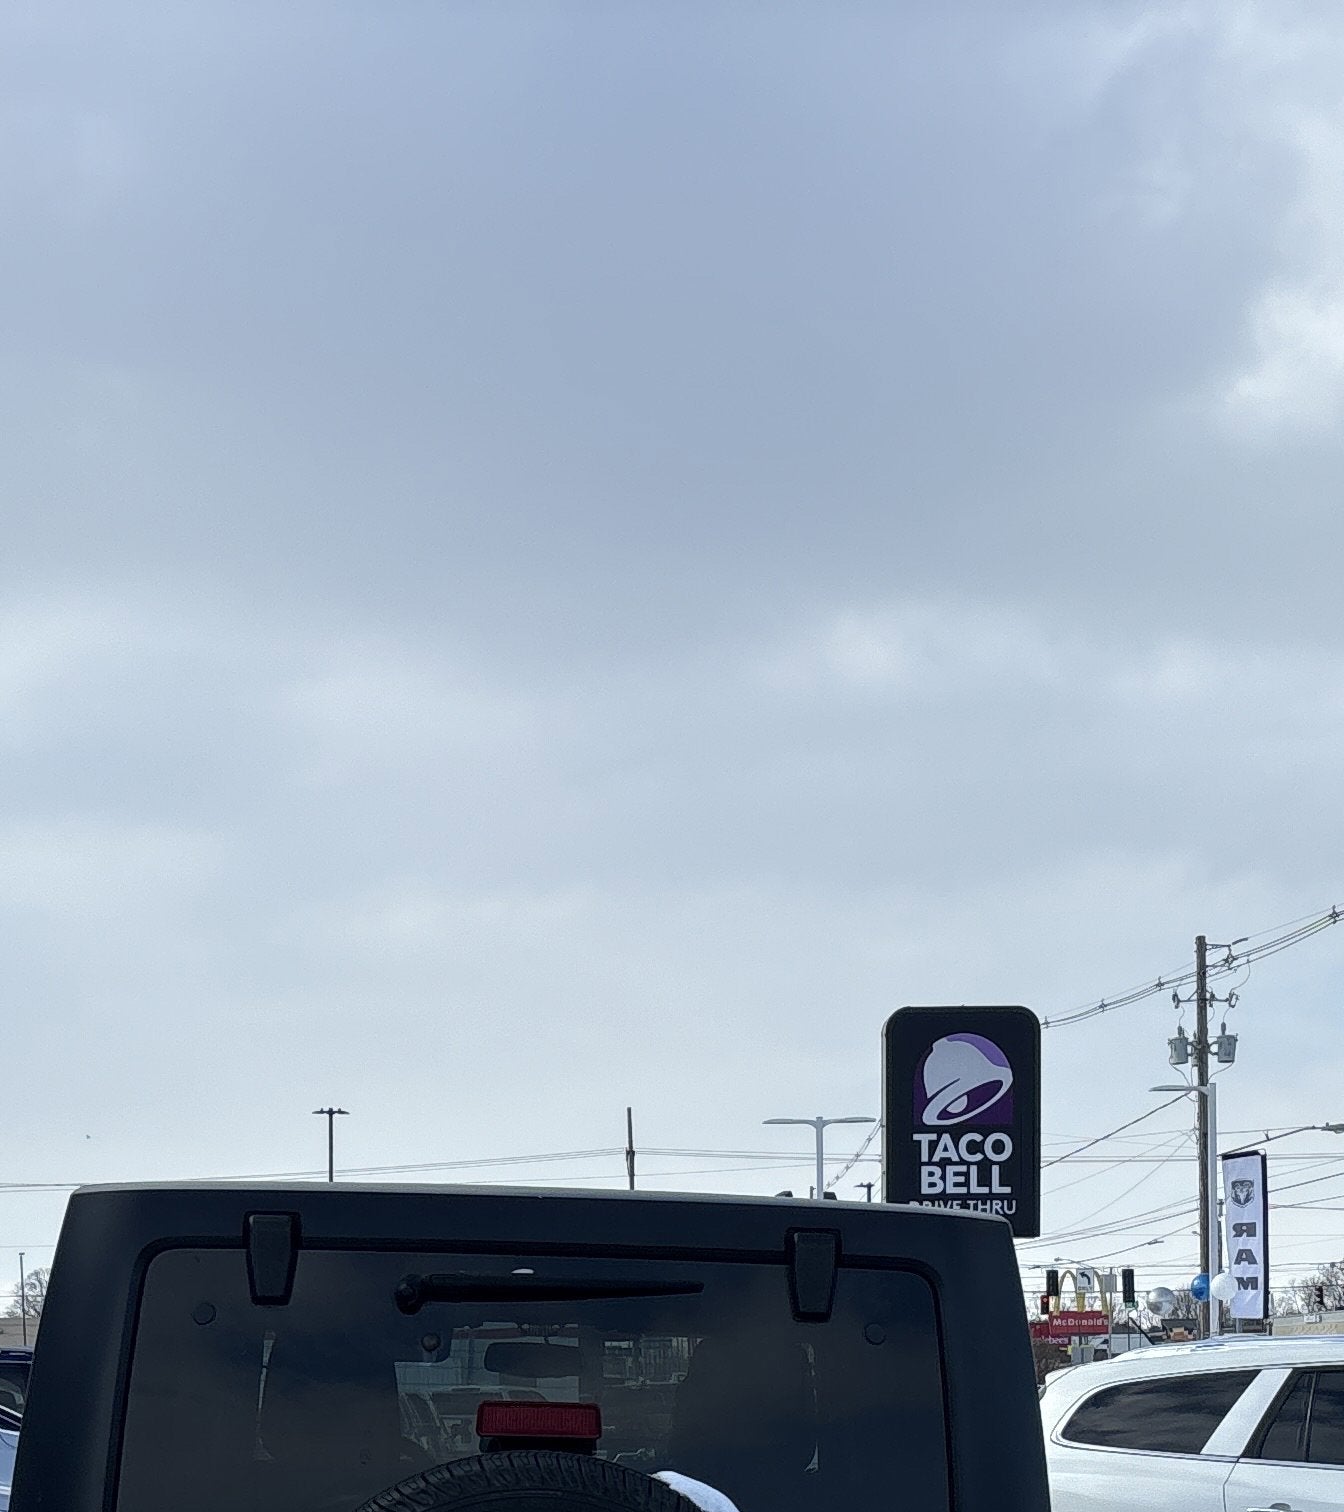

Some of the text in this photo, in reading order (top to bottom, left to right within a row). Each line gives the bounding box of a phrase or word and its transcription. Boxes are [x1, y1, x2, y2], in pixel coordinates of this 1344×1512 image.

[913, 1132, 1013, 1162] TACO
[921, 1164, 1012, 1195] BELL
[968, 1200, 1017, 1215] THRU
